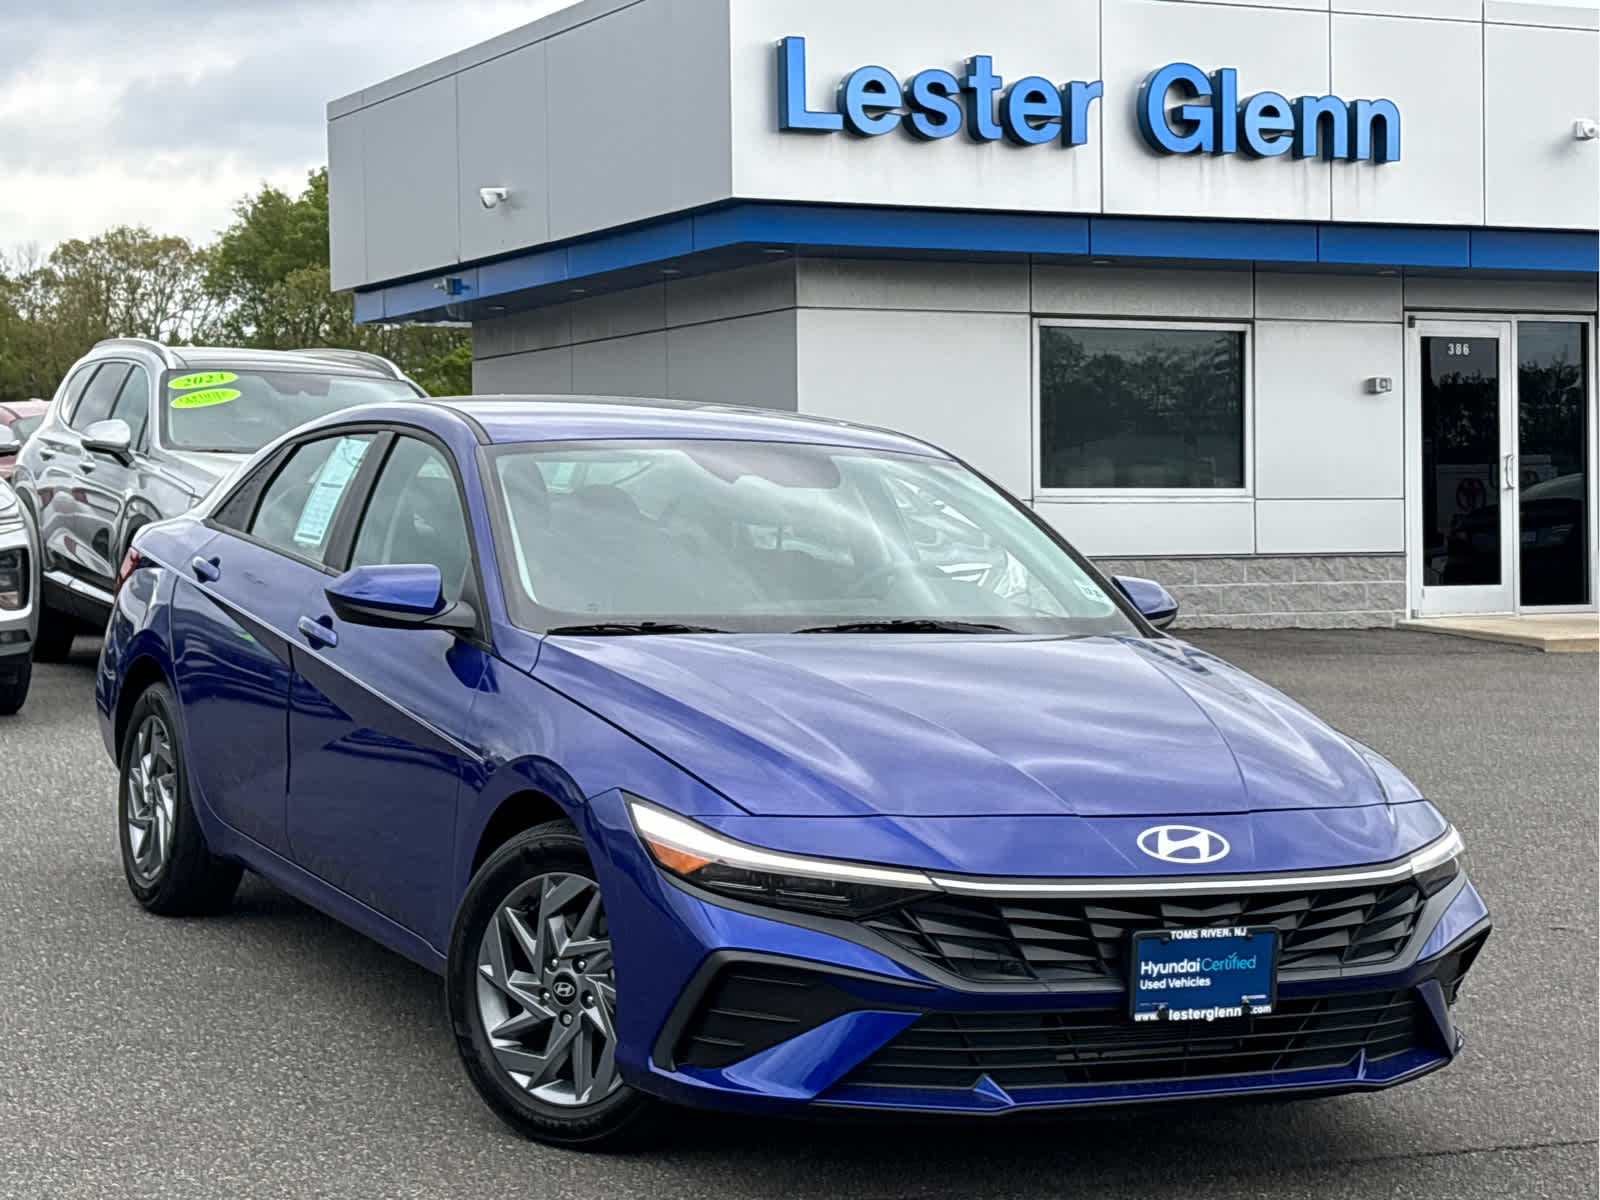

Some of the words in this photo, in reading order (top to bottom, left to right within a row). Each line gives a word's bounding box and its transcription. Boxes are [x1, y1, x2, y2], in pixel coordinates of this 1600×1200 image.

[777, 36, 1103, 147] Lester
[1137, 61, 1401, 163] Glenn
[1447, 343, 1470, 355] 386
[1170, 930, 1198, 940] TOMS
[1234, 927, 1247, 936] NJ
[1140, 978, 1166, 990] Used
[1168, 976, 1211, 988] Vehicles
